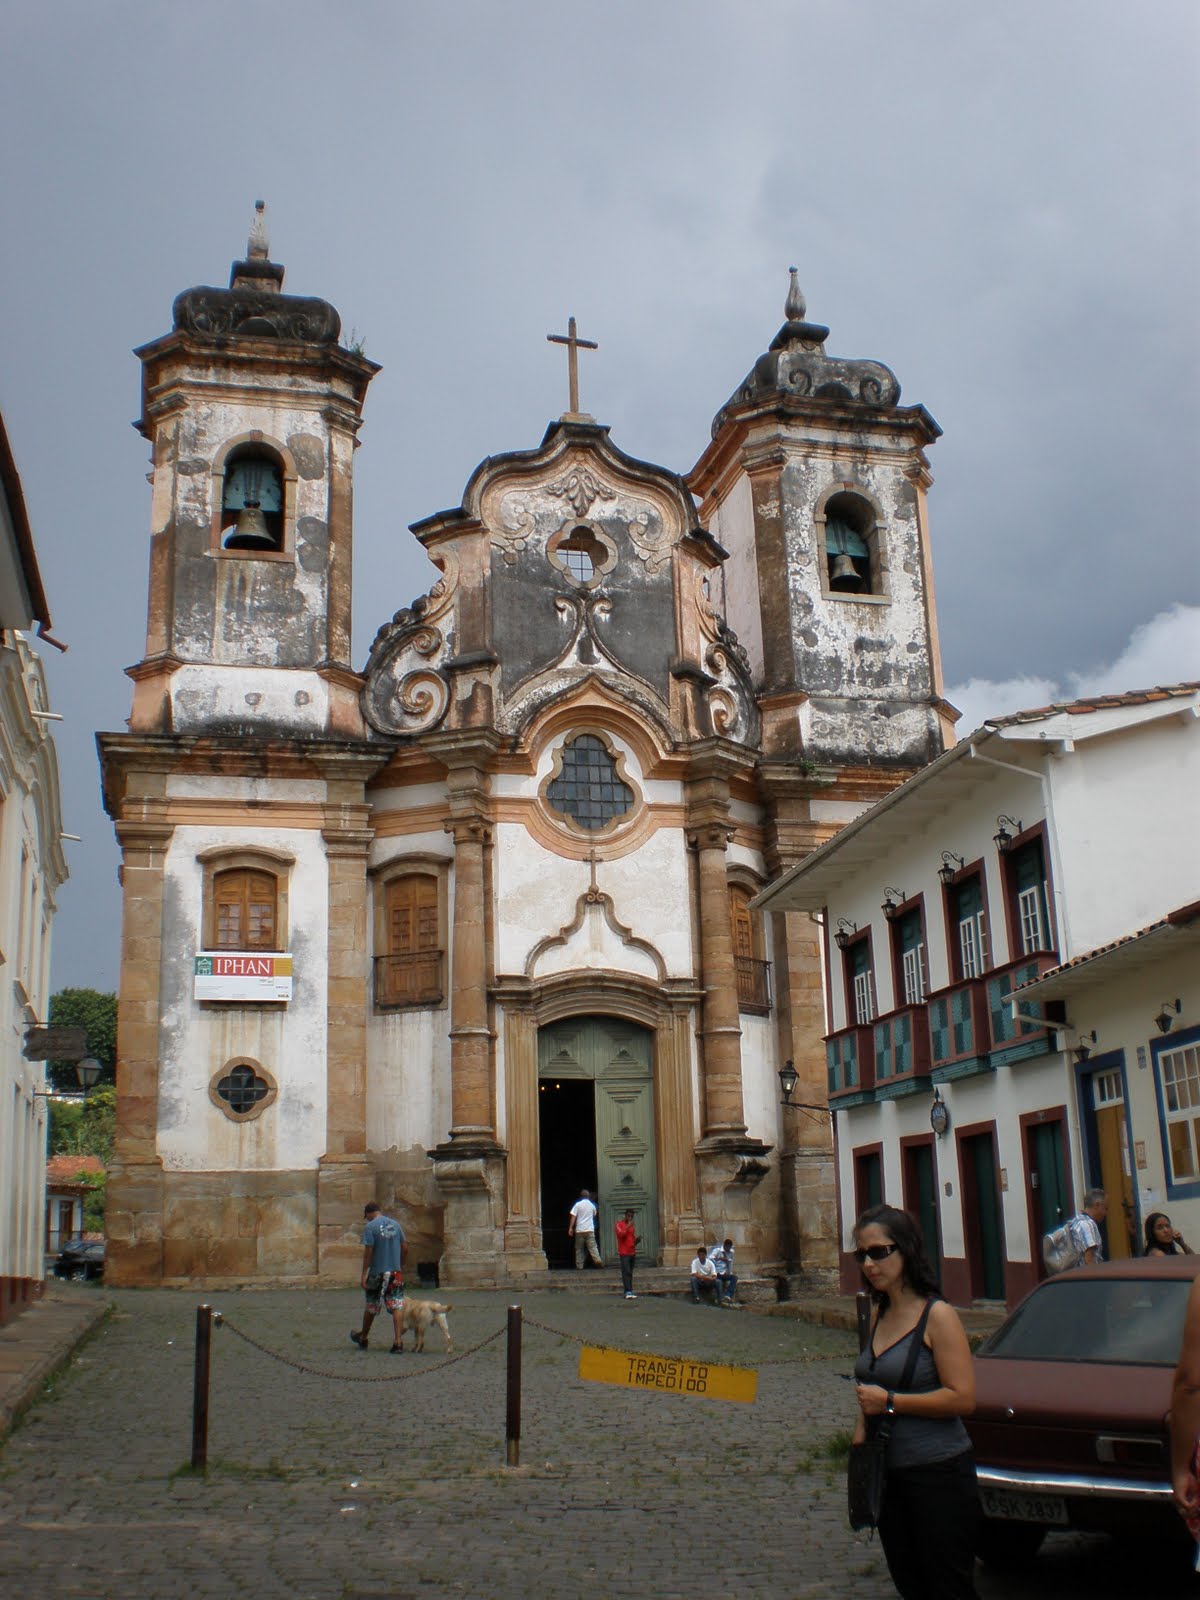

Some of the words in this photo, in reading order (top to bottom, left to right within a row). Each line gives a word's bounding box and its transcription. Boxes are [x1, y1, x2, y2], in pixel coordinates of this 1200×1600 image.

[217, 959, 270, 974] IPHAN
[628, 1358, 708, 1379] TRANSITO
[629, 1372, 706, 1392] IMPEDIDO
